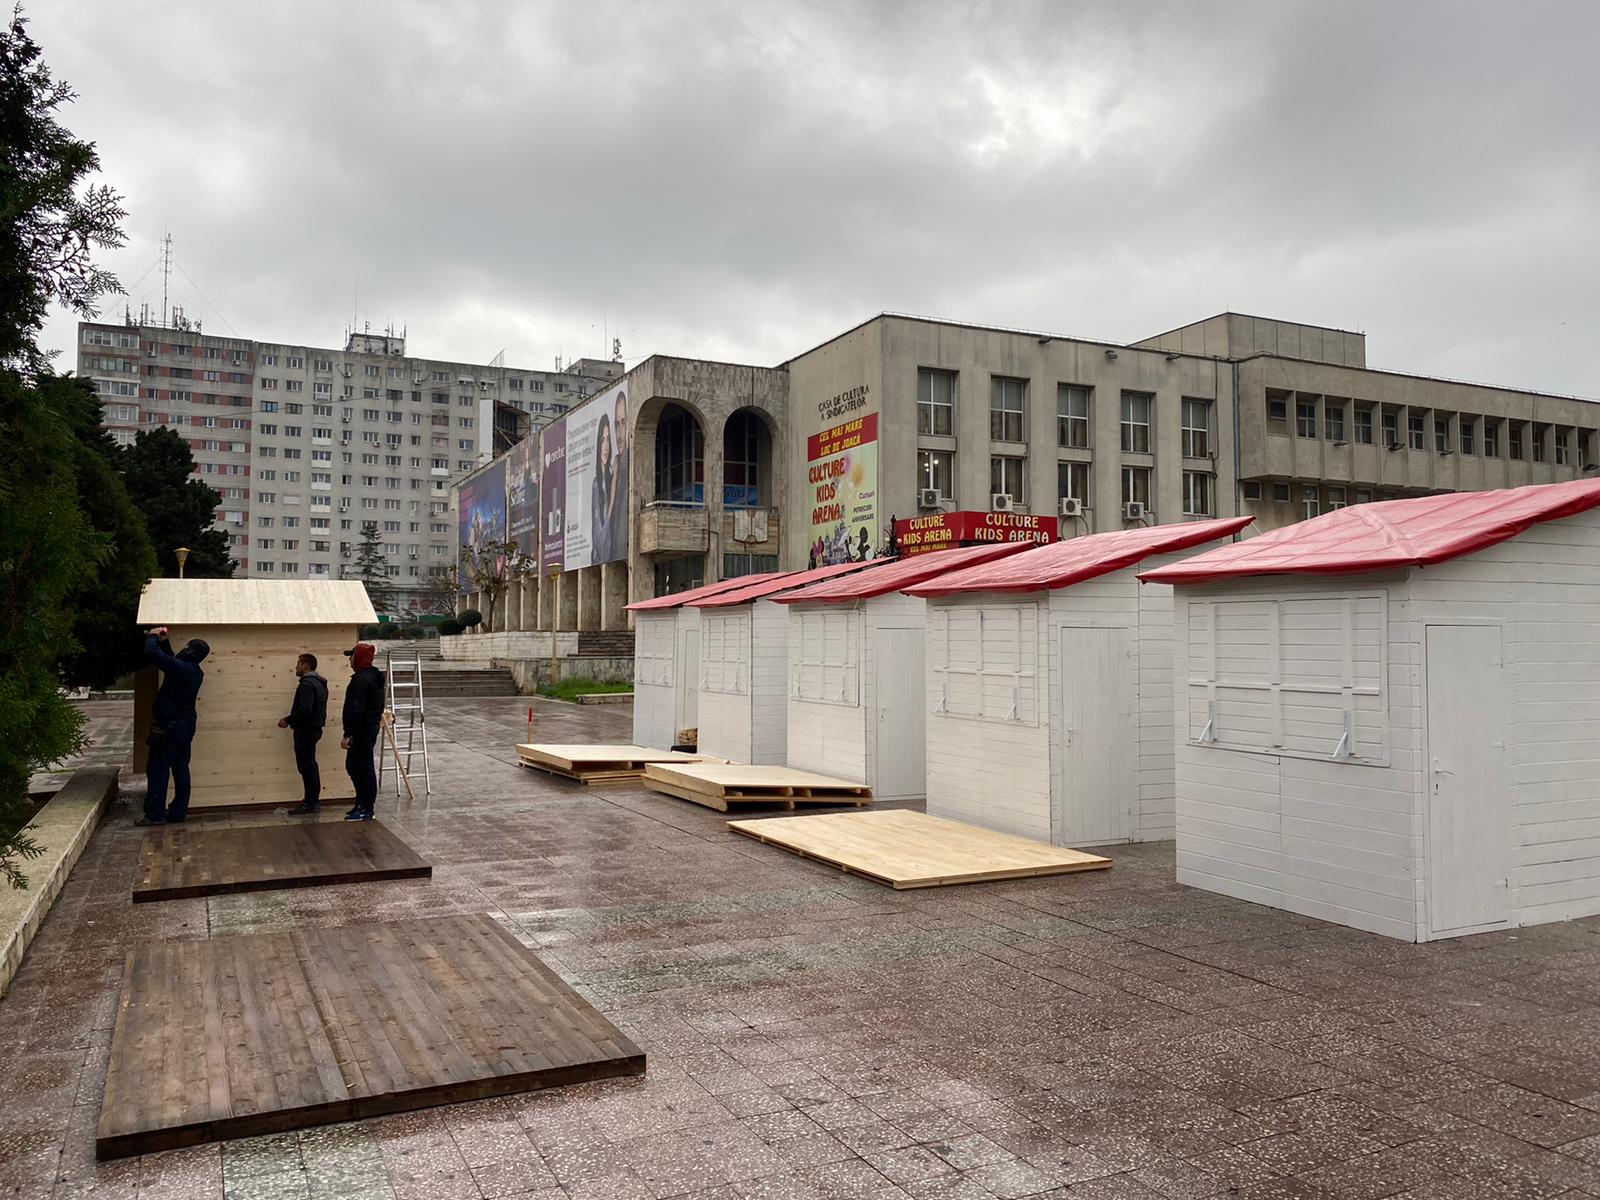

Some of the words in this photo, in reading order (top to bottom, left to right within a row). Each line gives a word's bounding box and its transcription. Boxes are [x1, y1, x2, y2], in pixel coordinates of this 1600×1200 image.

[818, 399, 833, 412] CASA
[833, 394, 842, 407] DE
[821, 413, 825, 422] A
[826, 396, 867, 420] SINDICATELOR
[819, 431, 830, 443] CEL
[831, 425, 844, 439] MAI
[844, 418, 864, 434] MARE
[821, 445, 831, 456] LOC
[832, 441, 841, 453] DE
[809, 458, 845, 484] CULTURE
[816, 481, 836, 503] KIDS
[812, 502, 841, 526] ARENA
[910, 515, 945, 530] CULTURE
[986, 513, 1039, 528] CULTURE
[903, 531, 922, 545] KIDS
[924, 528, 952, 543] ARENA
[975, 528, 1003, 541] KIDS
[1009, 530, 1049, 543] ARENA
